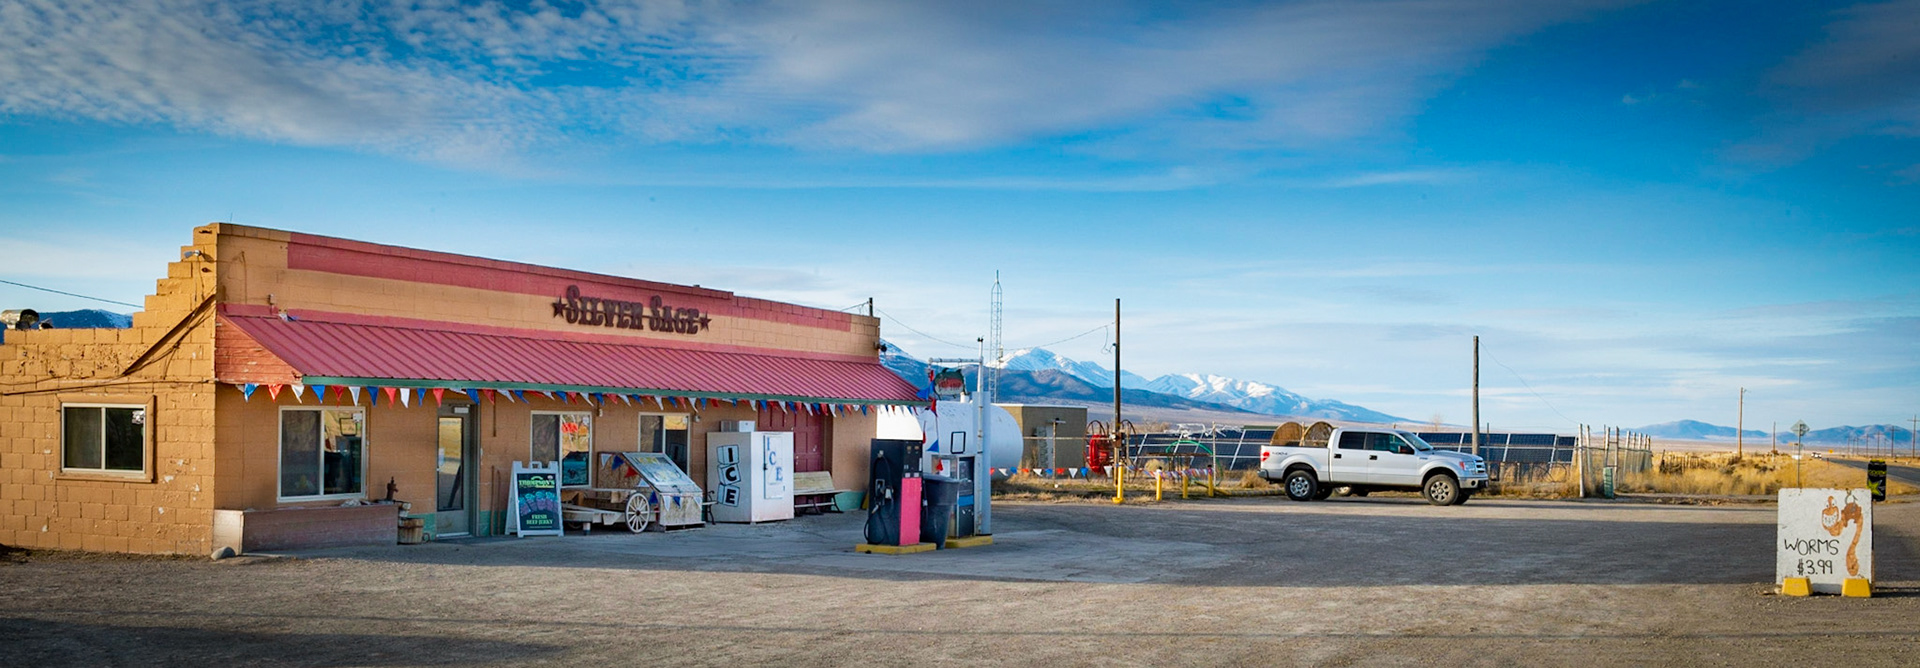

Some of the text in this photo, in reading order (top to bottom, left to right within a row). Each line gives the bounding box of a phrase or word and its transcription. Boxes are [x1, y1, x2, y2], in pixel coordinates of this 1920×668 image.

[566, 285, 701, 335] SILVER SAGE
[725, 448, 737, 505] ICE
[767, 437, 783, 481] ICE
[1784, 538, 1840, 556] WORMS
[1797, 559, 1833, 576] $3.99
